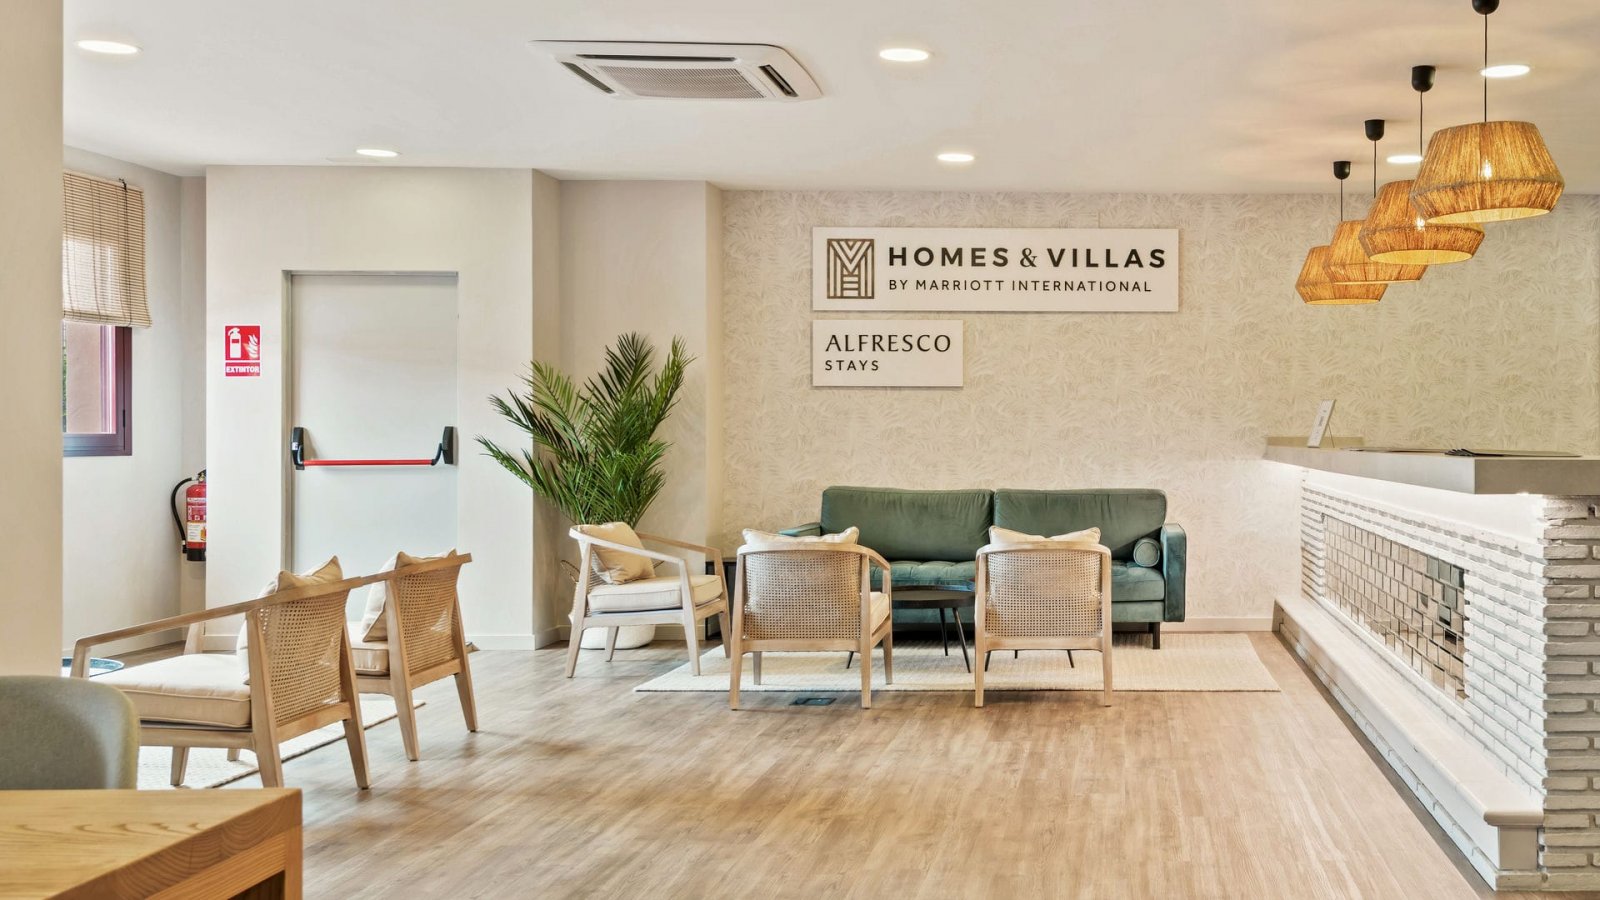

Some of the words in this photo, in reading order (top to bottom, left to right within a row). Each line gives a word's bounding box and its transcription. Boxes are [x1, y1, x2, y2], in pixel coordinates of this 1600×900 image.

[888, 246, 1009, 268] HOMES
[1019, 247, 1038, 268] &
[1046, 248, 1166, 269] VILLAS
[888, 279, 909, 291] BY
[915, 279, 1005, 292] MARRIOTT
[1012, 279, 1152, 293] INTERNATIONAL
[825, 334, 951, 353] ALFRESCO
[824, 359, 879, 372] STAYS
